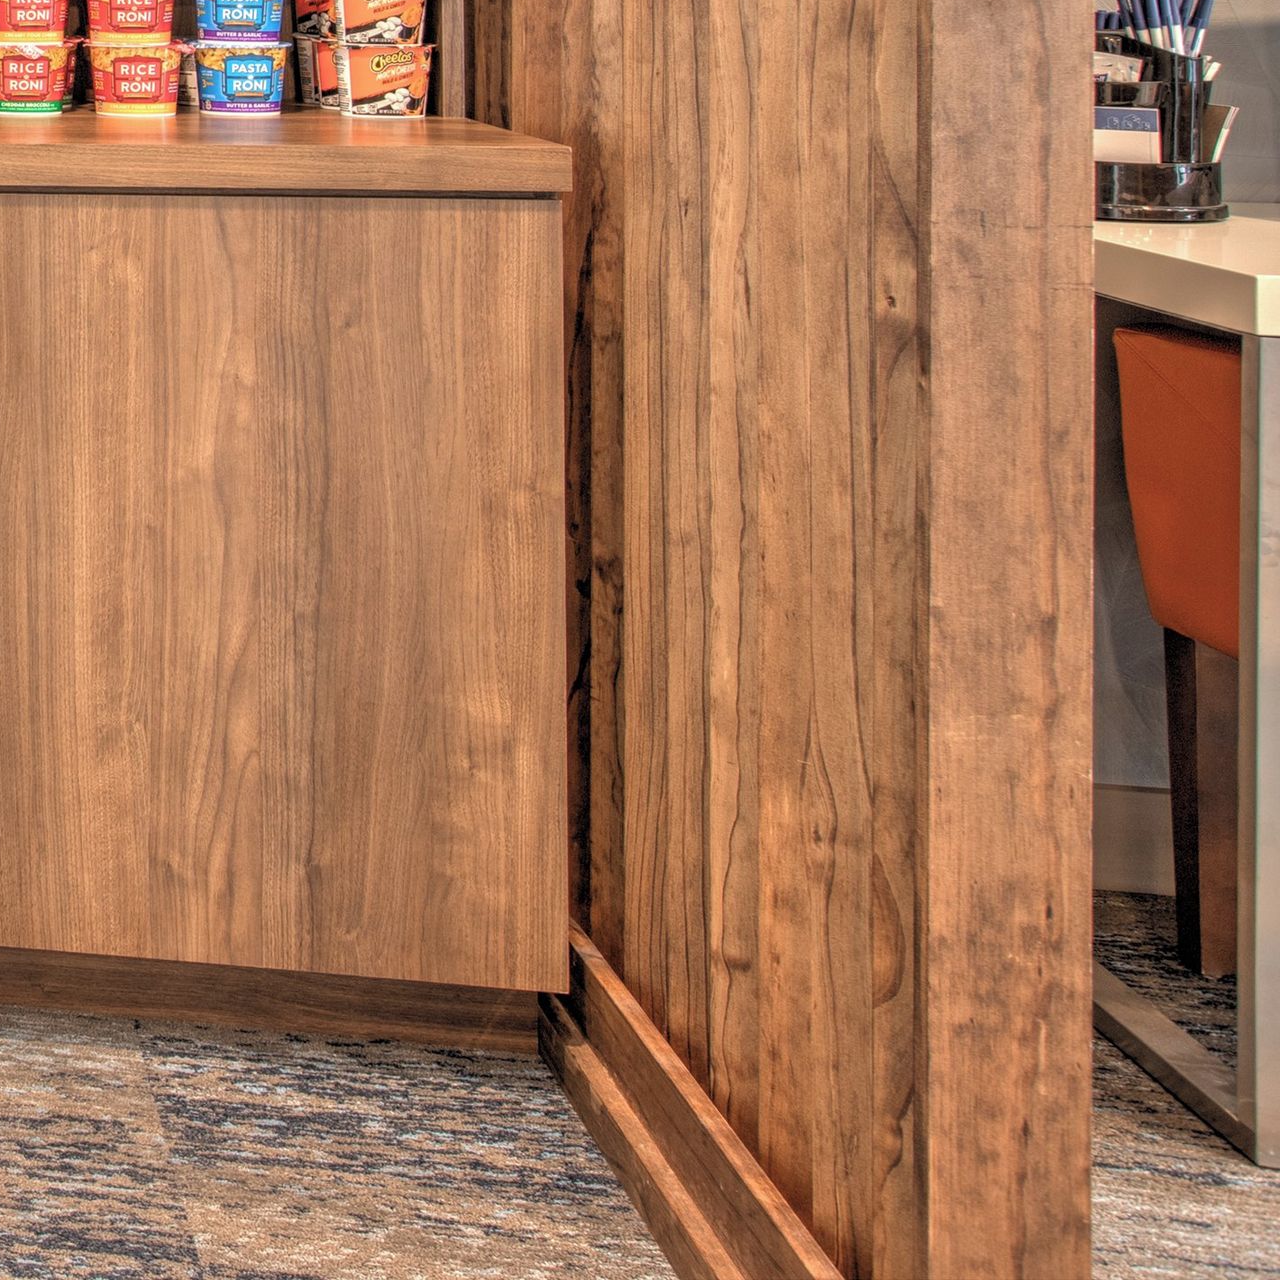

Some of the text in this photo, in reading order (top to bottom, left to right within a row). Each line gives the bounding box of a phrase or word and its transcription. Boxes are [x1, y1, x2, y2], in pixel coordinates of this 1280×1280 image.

[15, 8, 51, 22] RONI
[116, 10, 153, 23] RONI
[221, 8, 259, 21] RONI
[216, 31, 263, 39] BUTTER GARLIC
[8, 62, 45, 74] RICE
[230, 63, 270, 74] PASTA
[370, 50, 415, 74] Cheetos
[120, 64, 157, 76] RICE
[8, 79, 44, 92] RONI
[120, 81, 157, 93] RONI
[232, 79, 268, 92] RONI
